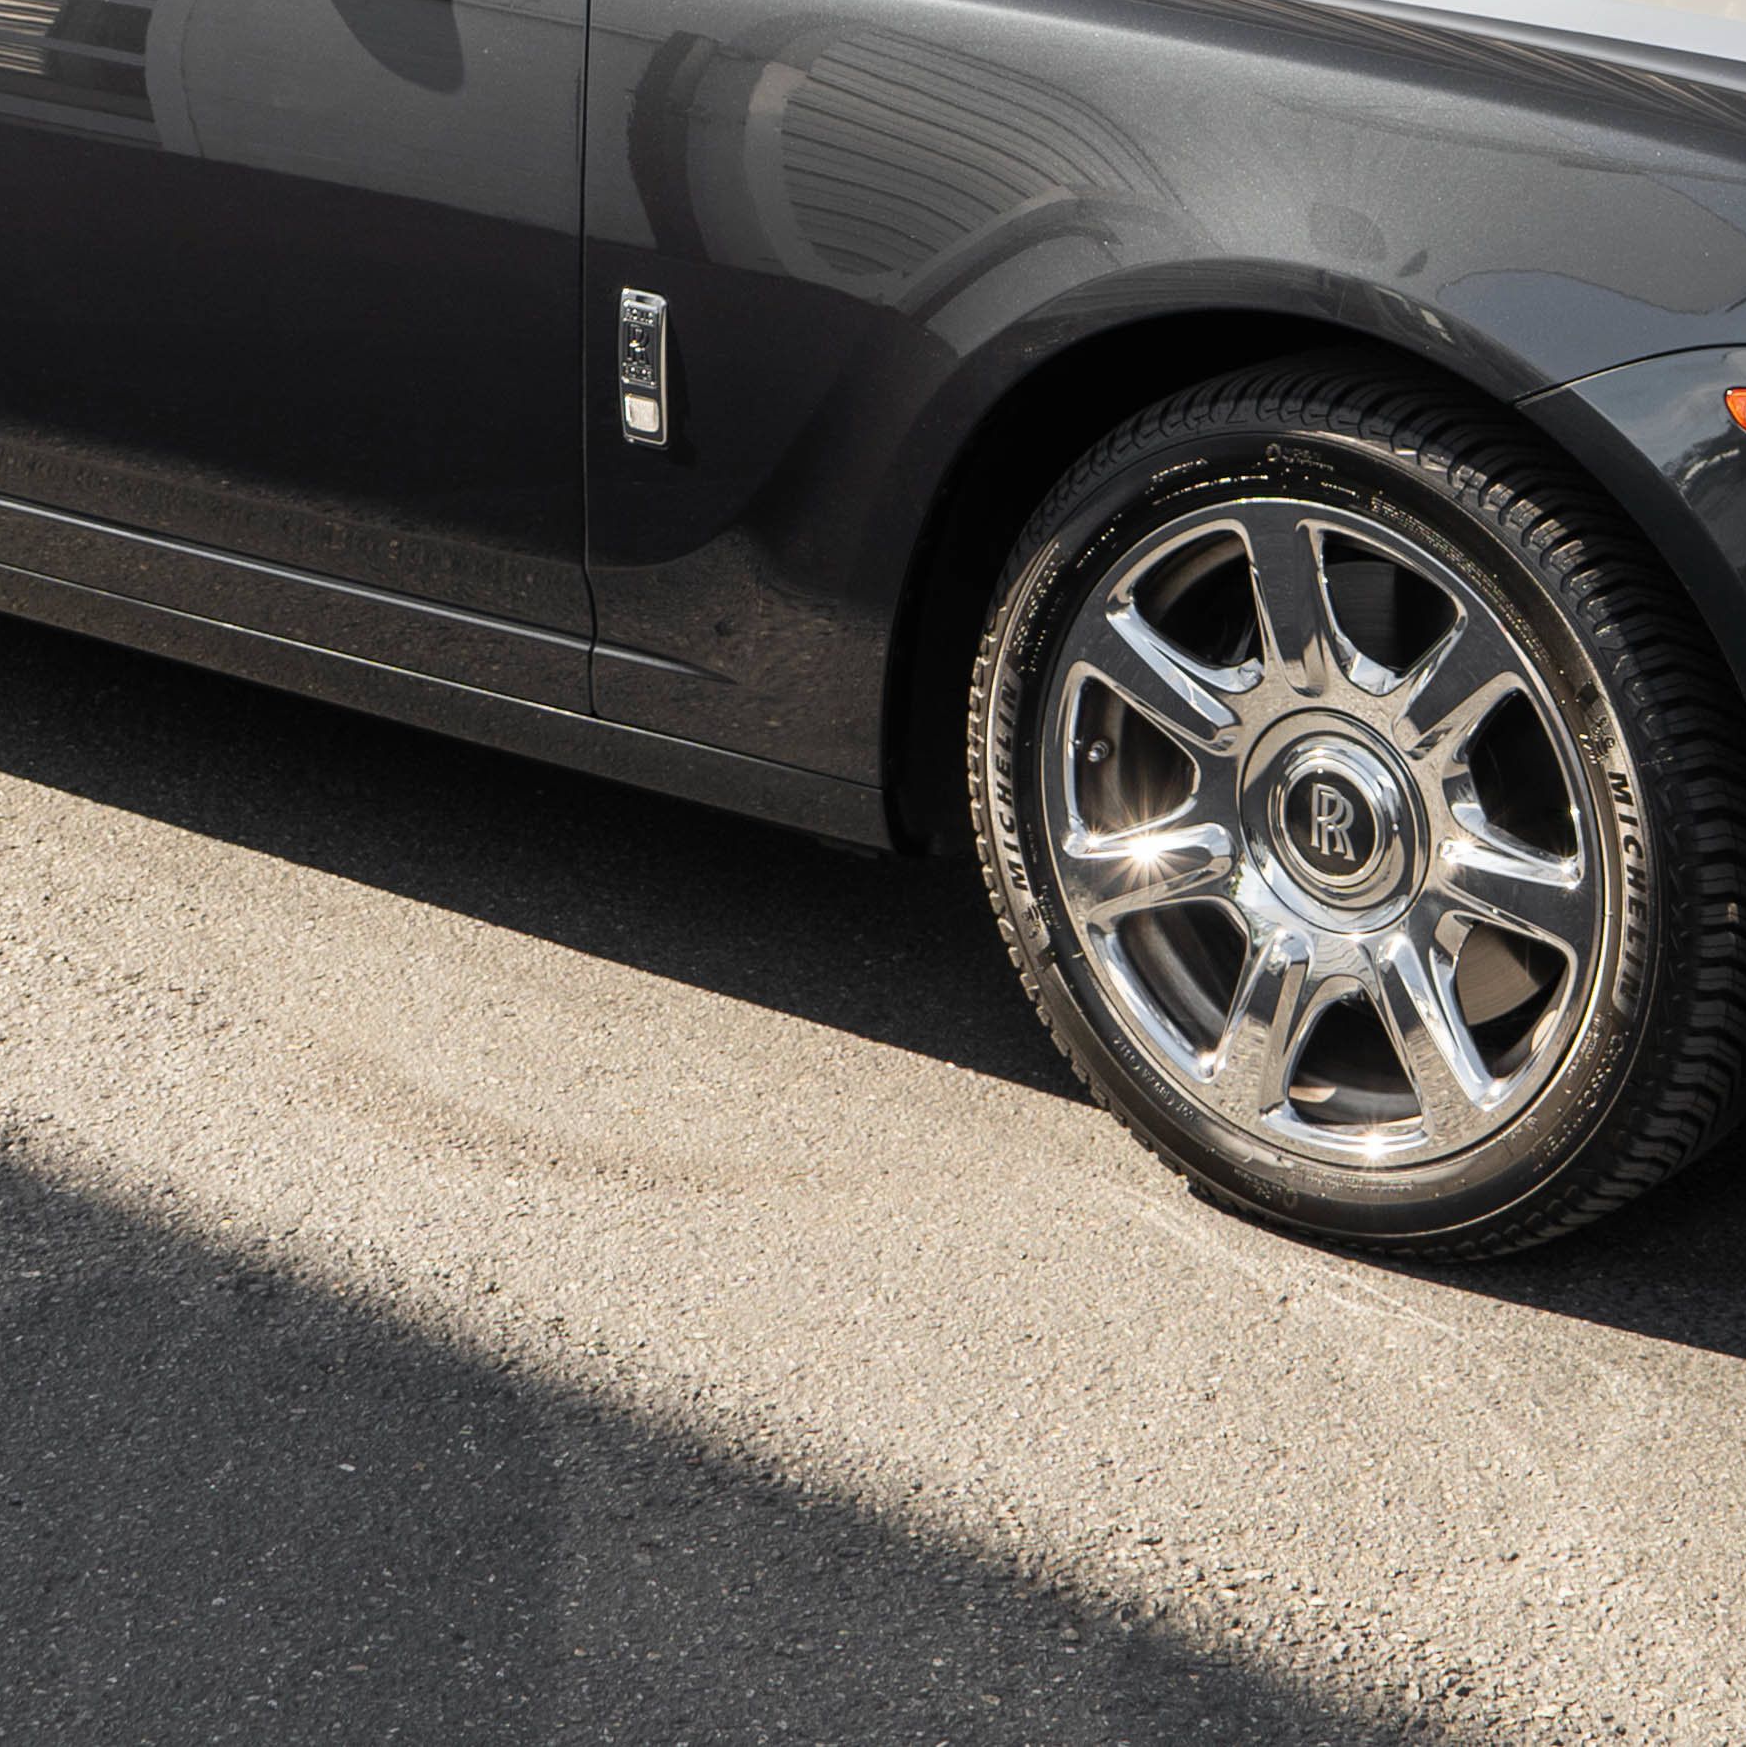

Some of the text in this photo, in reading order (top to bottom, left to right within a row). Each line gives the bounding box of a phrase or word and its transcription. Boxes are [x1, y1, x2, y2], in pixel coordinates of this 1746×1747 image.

[996, 680, 1029, 891] MICHELIN
[1311, 783, 1356, 861] RR
[1608, 771, 1647, 1001] MICHELIN
